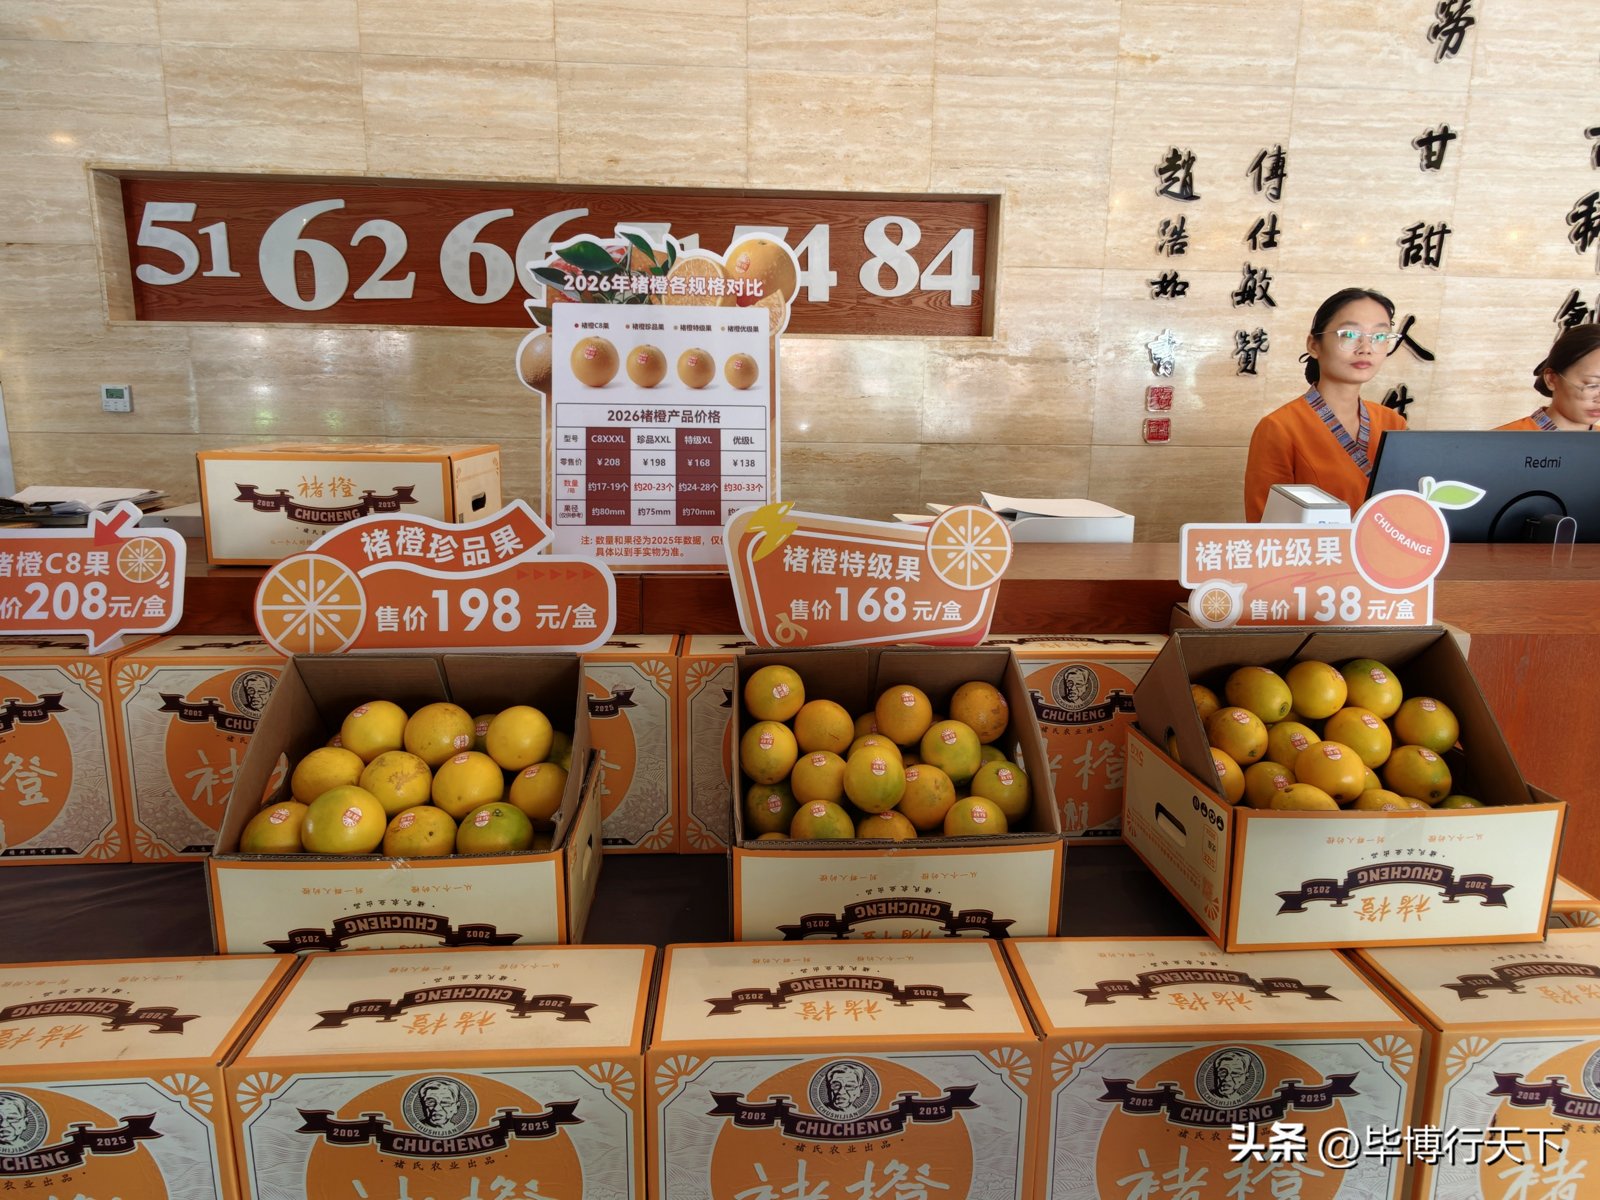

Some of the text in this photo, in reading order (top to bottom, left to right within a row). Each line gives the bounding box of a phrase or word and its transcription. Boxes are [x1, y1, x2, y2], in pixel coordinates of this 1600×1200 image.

[136, 202, 241, 285] 51
[259, 198, 416, 310] 62
[859, 216, 980, 306] 84
[563, 273, 763, 297] 2026年褚橙各规格对比
[607, 410, 721, 424] 2026褚橙产品价格
[563, 434, 755, 445] 型号 C8XXXL 珍品XXL 特级XL 优级L
[560, 458, 755, 468] 零售价 ¥208 ¥198 ¥168 ¥138
[1524, 456, 1562, 469] Redmi
[297, 475, 357, 498] 褚橙
[563, 479, 763, 493] 数量 约17-19个 约20-23个 约24-28个 约30-33个
[294, 508, 361, 524] CHUCHENG
[591, 507, 625, 516] 约80mm
[637, 507, 671, 516] 约75mm
[682, 508, 716, 516] 约70mm
[581, 536, 724, 546] 注：数量和果径为2025年数据，仅
[1373, 512, 1433, 556] CHUORANGE
[360, 523, 523, 566] 褚橙珍品果
[595, 548, 685, 557] 具体以到手实物为准。
[1195, 536, 1342, 571] 褚橙优级果
[784, 545, 920, 583] 褚橙特级果
[1042, 708, 1106, 723] CHUCHENG
[1357, 865, 1443, 883] CHUCHENG
[1464, 880, 1487, 889] 2002
[854, 901, 941, 918] CHUCHENG
[1353, 893, 1431, 924] 褚橙
[344, 915, 438, 933] CHUCHENG
[965, 915, 988, 924] 2002
[466, 930, 491, 940] 2002
[1150, 970, 1240, 985] CHUCHENG
[1503, 963, 1595, 978] CHUCHENG
[790, 978, 883, 993] CHUCHENG
[913, 988, 939, 997] 2002
[413, 987, 514, 1004] CHUCHENG
[738, 992, 764, 1000] 2025
[11, 1001, 120, 1018] CHUCHENG
[353, 1004, 383, 1014] 2025
[538, 999, 566, 1008] 2002
[794, 999, 884, 1022] 褚橙
[402, 1010, 496, 1035] 褚橙
[1130, 1097, 1154, 1107] 2002
[1203, 1092, 1242, 1106] CHUSHIJIAN
[1300, 1092, 1327, 1103] 2025
[1517, 1091, 1541, 1100] 2002
[741, 1110, 767, 1121] 2002
[818, 1105, 859, 1120] CHUSHIJIAN
[918, 1105, 946, 1116] 2025
[1180, 1105, 1273, 1123] CHUCHENG
[1565, 1101, 1600, 1115] CHU
[332, 1127, 361, 1138] 2002
[413, 1121, 458, 1137] CHUSHIJIAN
[521, 1119, 550, 1131] 2025
[794, 1117, 892, 1136] CHUCHENG
[96, 1135, 127, 1147] 2025
[392, 1133, 495, 1154] CHUCHENG
[794, 1140, 892, 1155] 褚氏农业出品
[0, 1150, 70, 1171] CHENG
[394, 1155, 496, 1171] 褚氏农业出品
